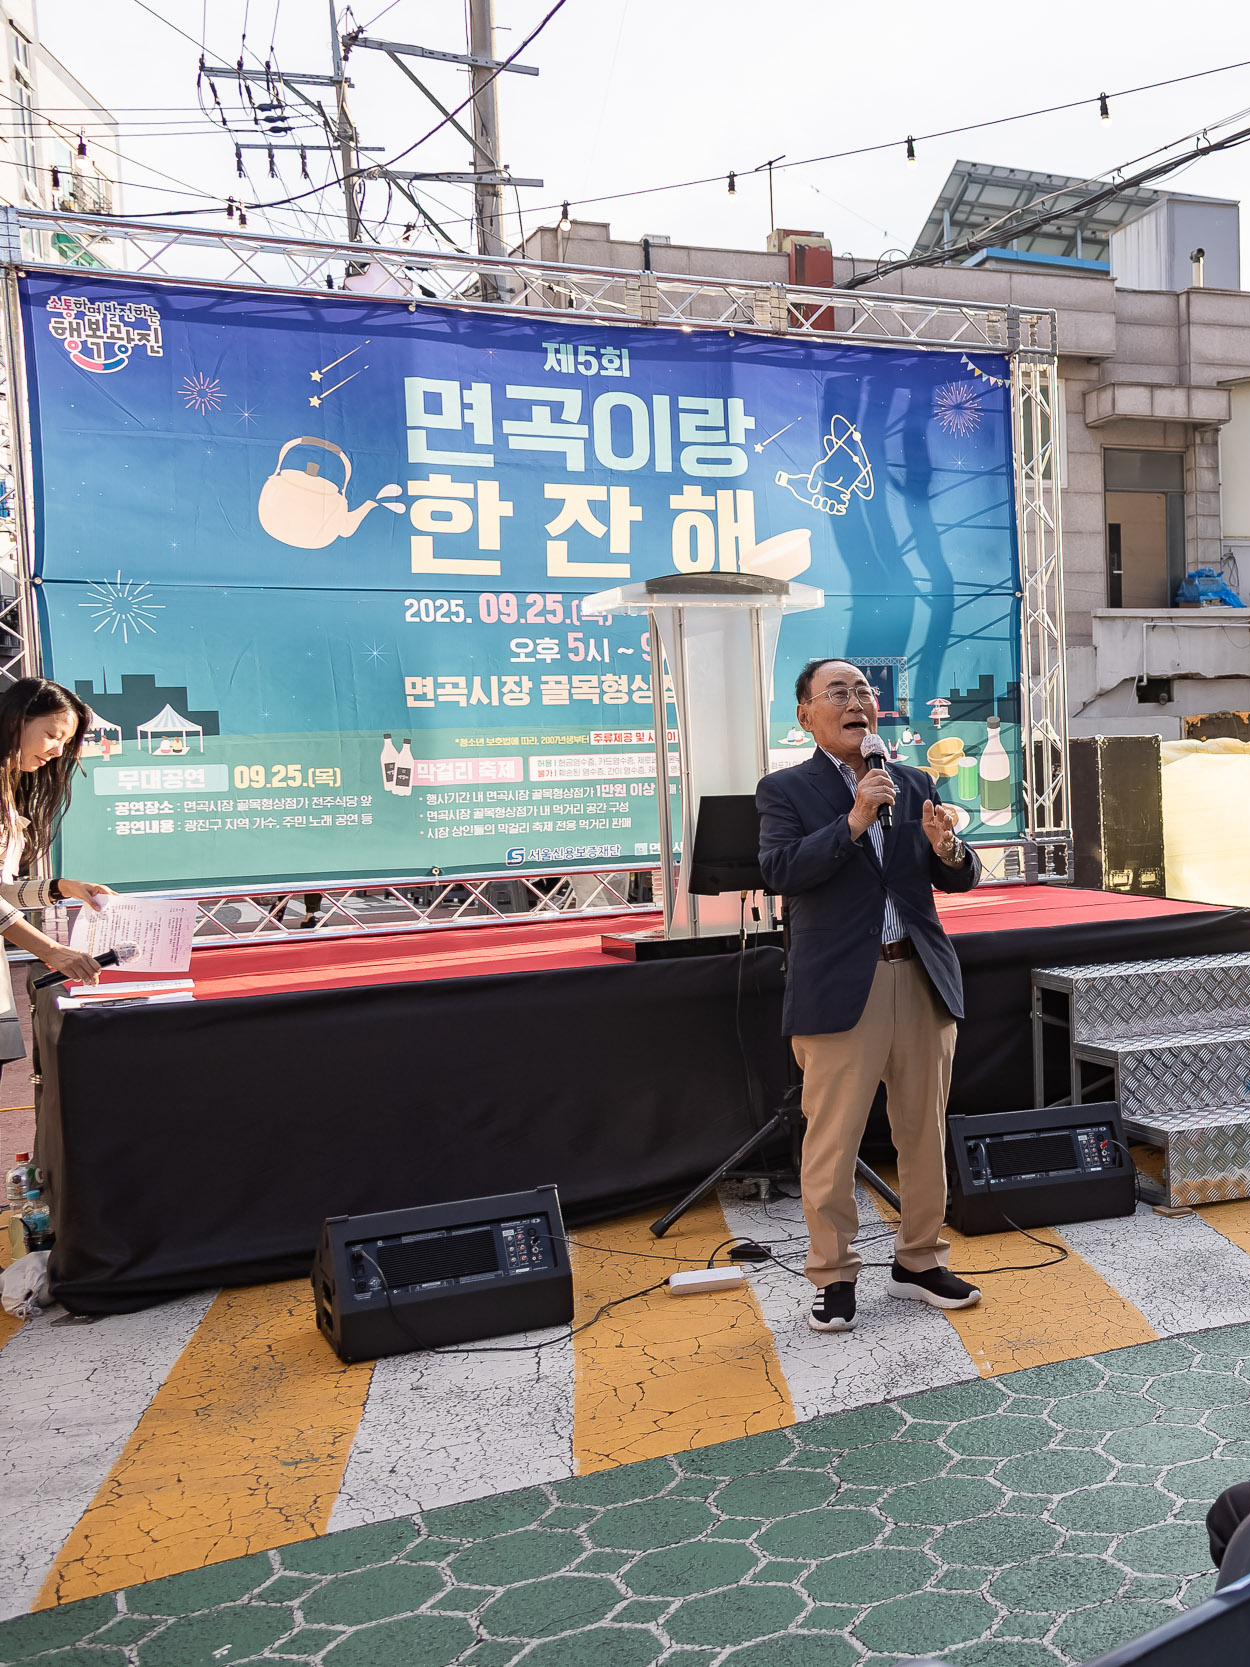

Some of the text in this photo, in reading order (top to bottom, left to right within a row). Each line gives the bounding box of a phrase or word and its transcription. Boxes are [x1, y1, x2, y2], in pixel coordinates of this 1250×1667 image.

[47, 296, 160, 325] 소통하며 발전하는
[49, 317, 163, 361] 행복광진
[541, 342, 630, 377] 제5회
[404, 377, 756, 477] 면곡이랑
[407, 474, 756, 578] 한 잔 해
[405, 598, 472, 623] 2025.
[510, 637, 560, 663] 오후
[567, 632, 610, 663] 5시
[405, 675, 533, 707] 면곡시장
[593, 732, 632, 743] 주류제공
[636, 732, 645, 743] 및
[118, 764, 341, 791] 무대공연 09.25.(목)
[417, 760, 472, 783] 막걸리
[479, 759, 515, 779] 축제
[114, 800, 174, 816] 공연장소
[184, 800, 234, 813] 면곡시장
[237, 797, 309, 811] 골목형상점가
[311, 796, 358, 808] 전주식당
[360, 795, 372, 807] 앞
[426, 792, 470, 805] 행사기간
[473, 791, 483, 803] 내
[487, 789, 529, 802] 면곡시장
[532, 787, 594, 801] 골목형상점가
[596, 783, 626, 797] 1만원
[630, 782, 655, 796] 이상
[115, 819, 174, 835] 공연내용
[184, 819, 222, 832] 광진구
[225, 818, 249, 830] 지역
[252, 817, 280, 829] 가수,
[283, 816, 306, 827] 주민
[309, 815, 332, 826] 노래
[335, 813, 358, 826] 공연
[361, 813, 373, 825] 등
[427, 801, 629, 822] 면곡시장 골목형상점가 내 먹거리 공간 구성
[427, 817, 631, 839] 시장 상인들의 막걸리 축제 전용 먹거리 판매
[528, 844, 621, 862] 서울신용보증재단
